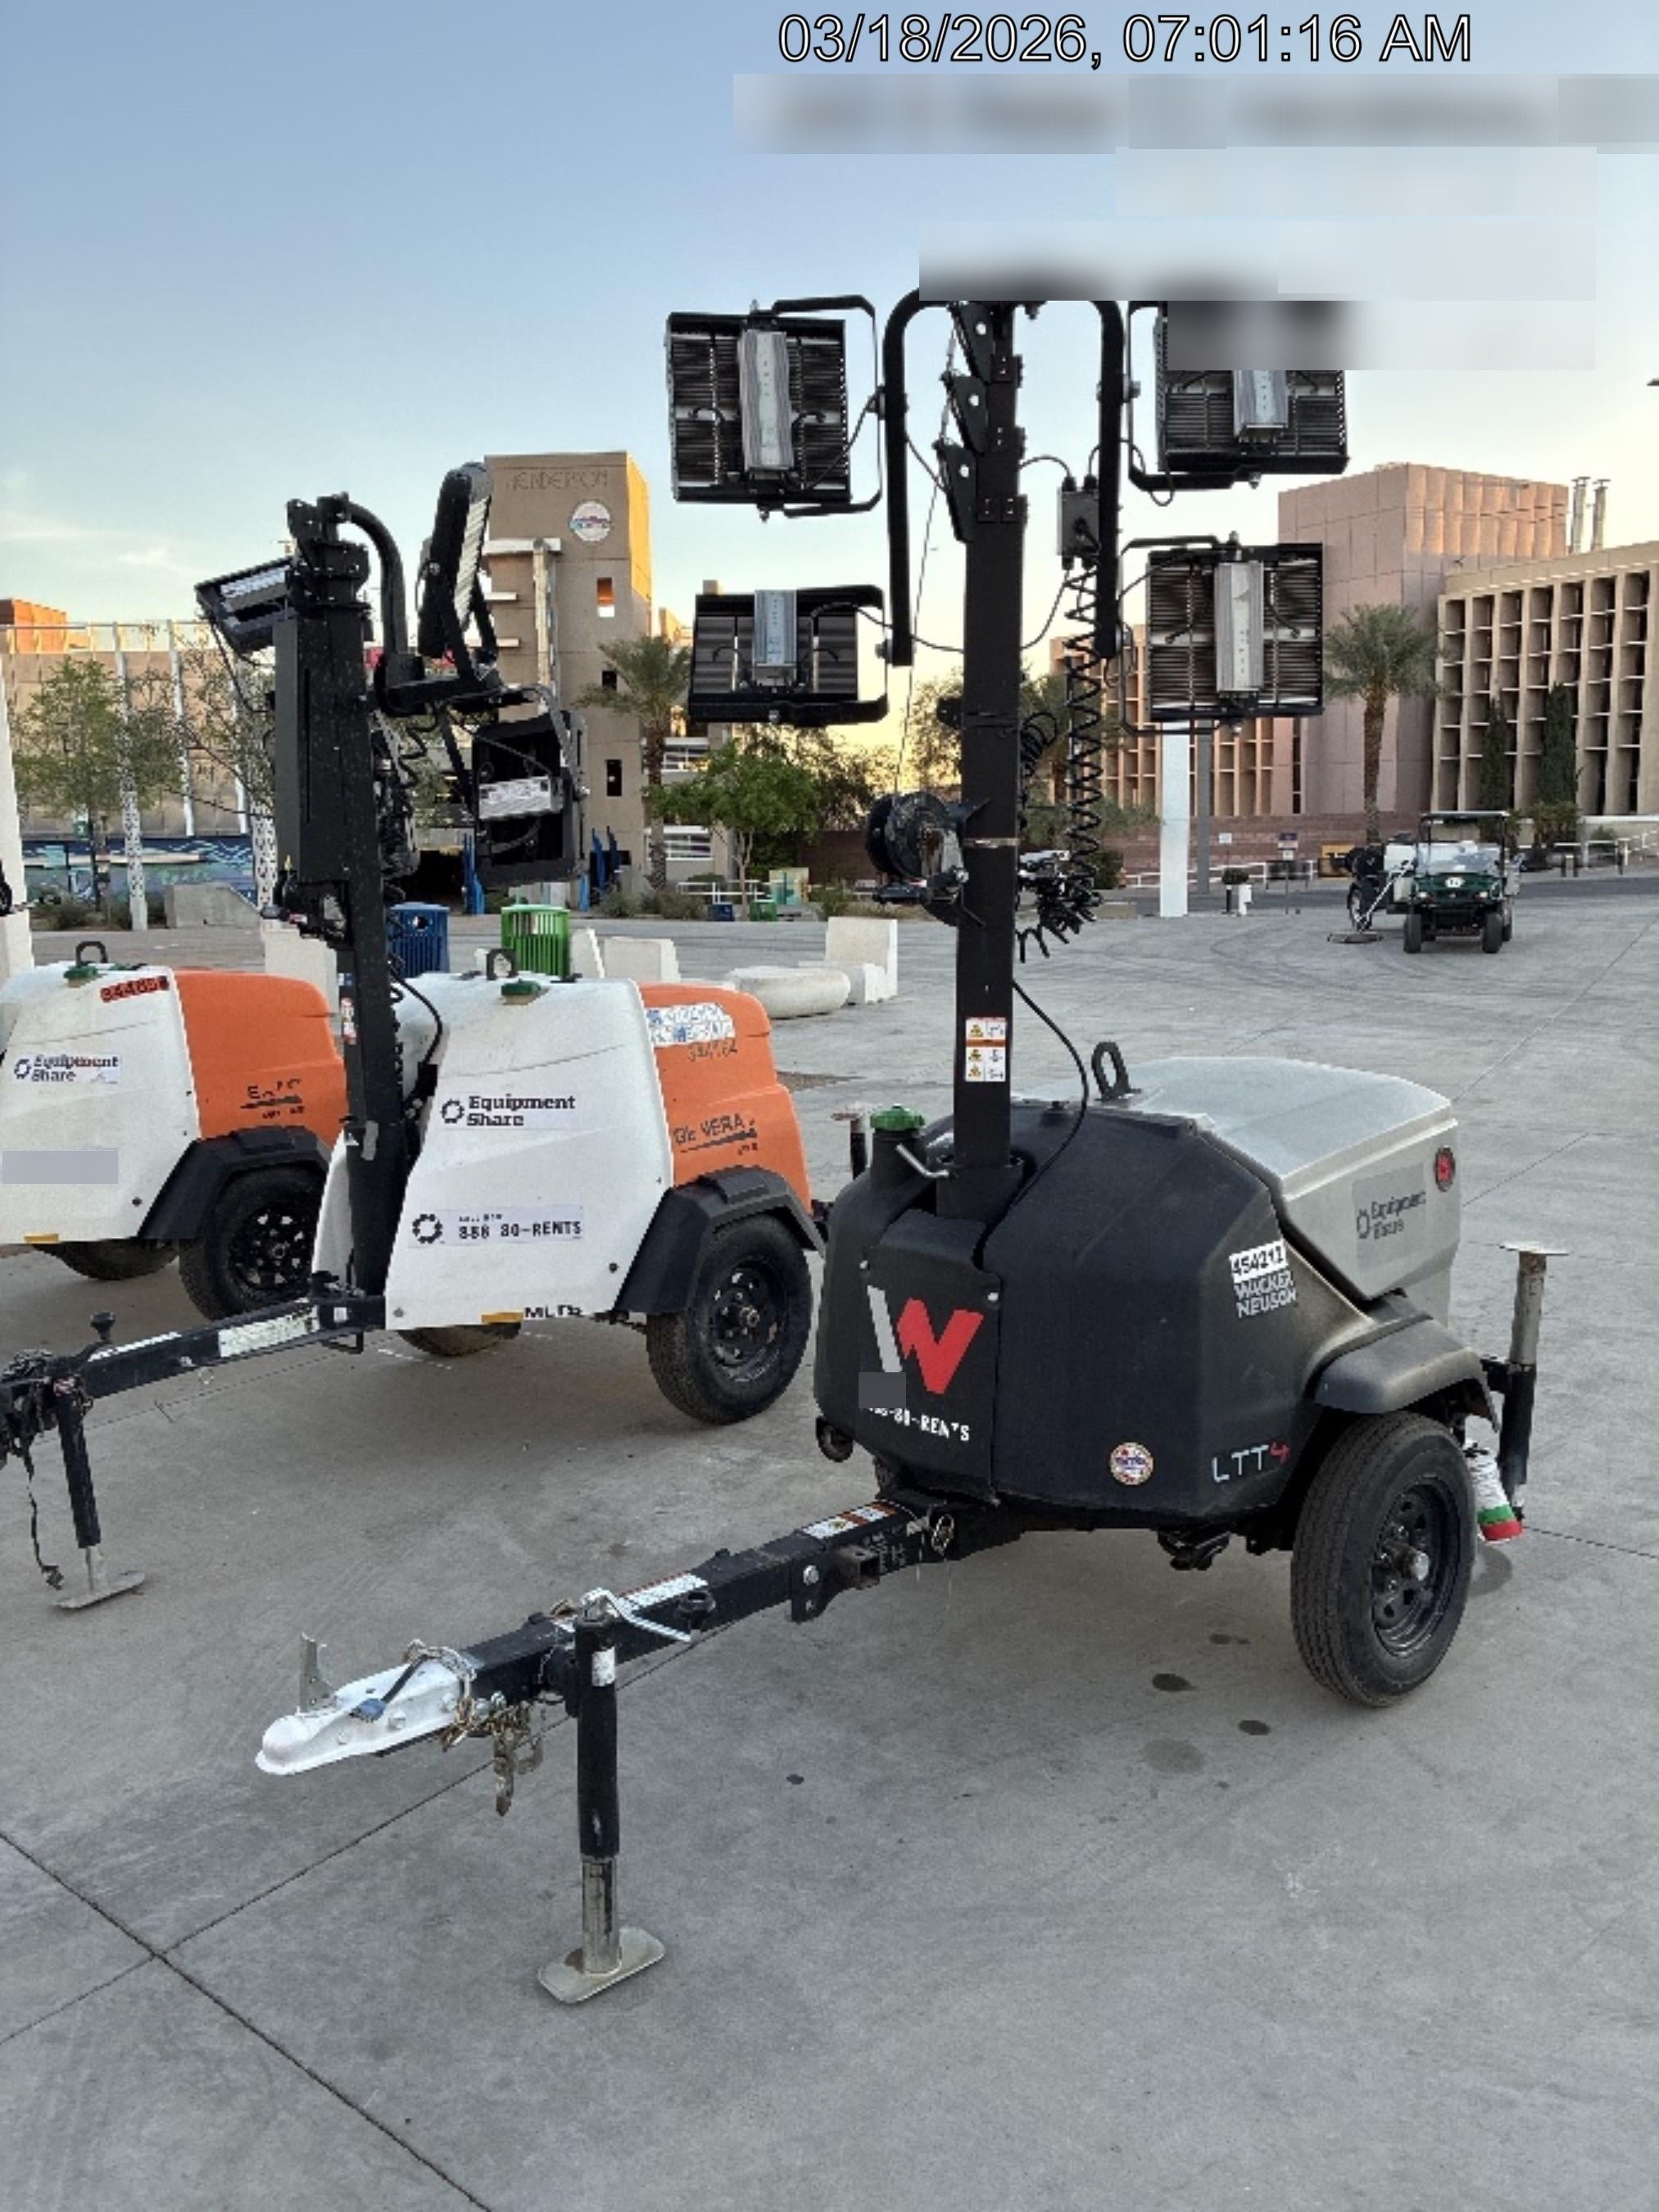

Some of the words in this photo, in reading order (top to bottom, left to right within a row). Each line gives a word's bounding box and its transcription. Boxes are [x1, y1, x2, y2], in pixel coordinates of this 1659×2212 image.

[468, 1093, 576, 1112] Equipment
[465, 1113, 524, 1126] Share
[1235, 1287, 1297, 1318] NEUSON
[1213, 1442, 1291, 1483] LTT4
